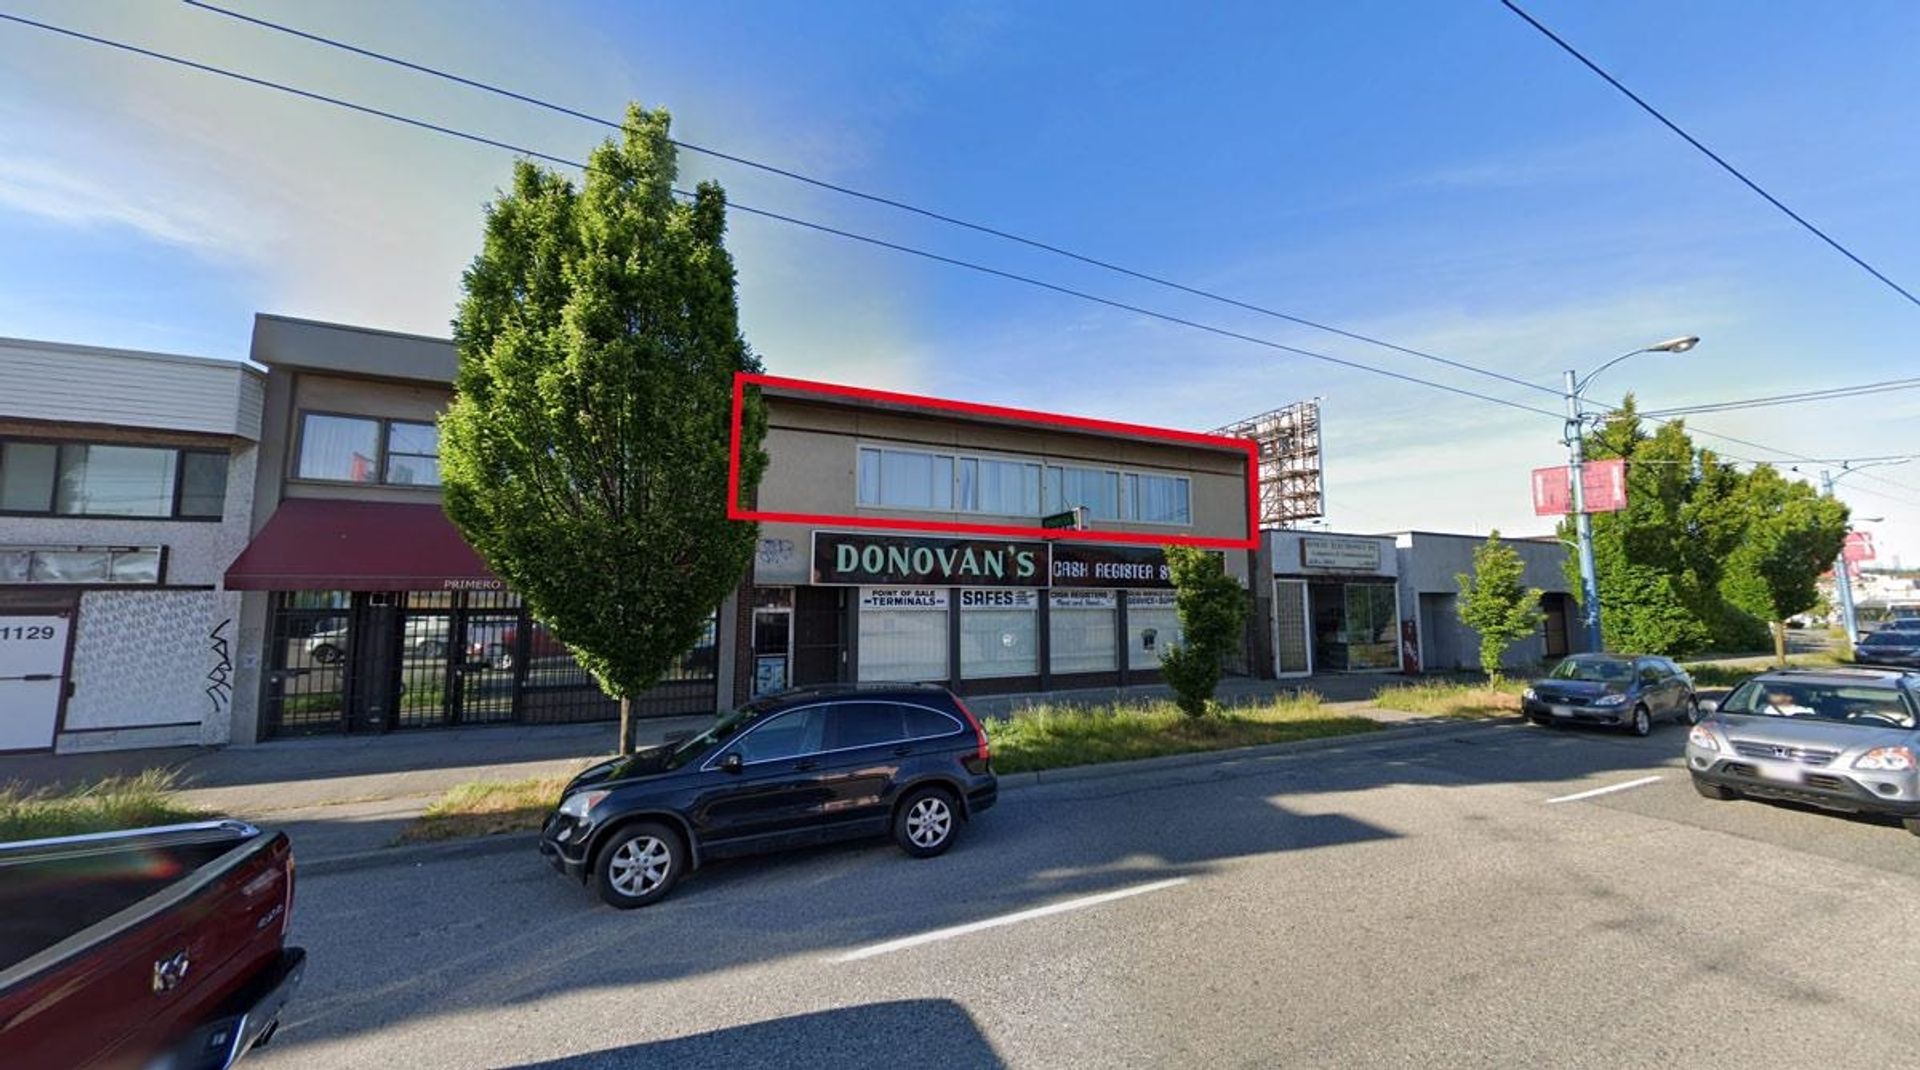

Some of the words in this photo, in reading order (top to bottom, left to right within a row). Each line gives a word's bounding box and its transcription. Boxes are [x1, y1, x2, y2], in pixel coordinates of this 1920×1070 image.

[836, 543, 1035, 578] DONOVAN'S
[1053, 560, 1088, 577] CASH
[1095, 562, 1153, 579] REGISTER
[444, 580, 501, 590] PRIMERO
[963, 590, 1013, 606] SAFES
[0, 626, 54, 640] 1129
